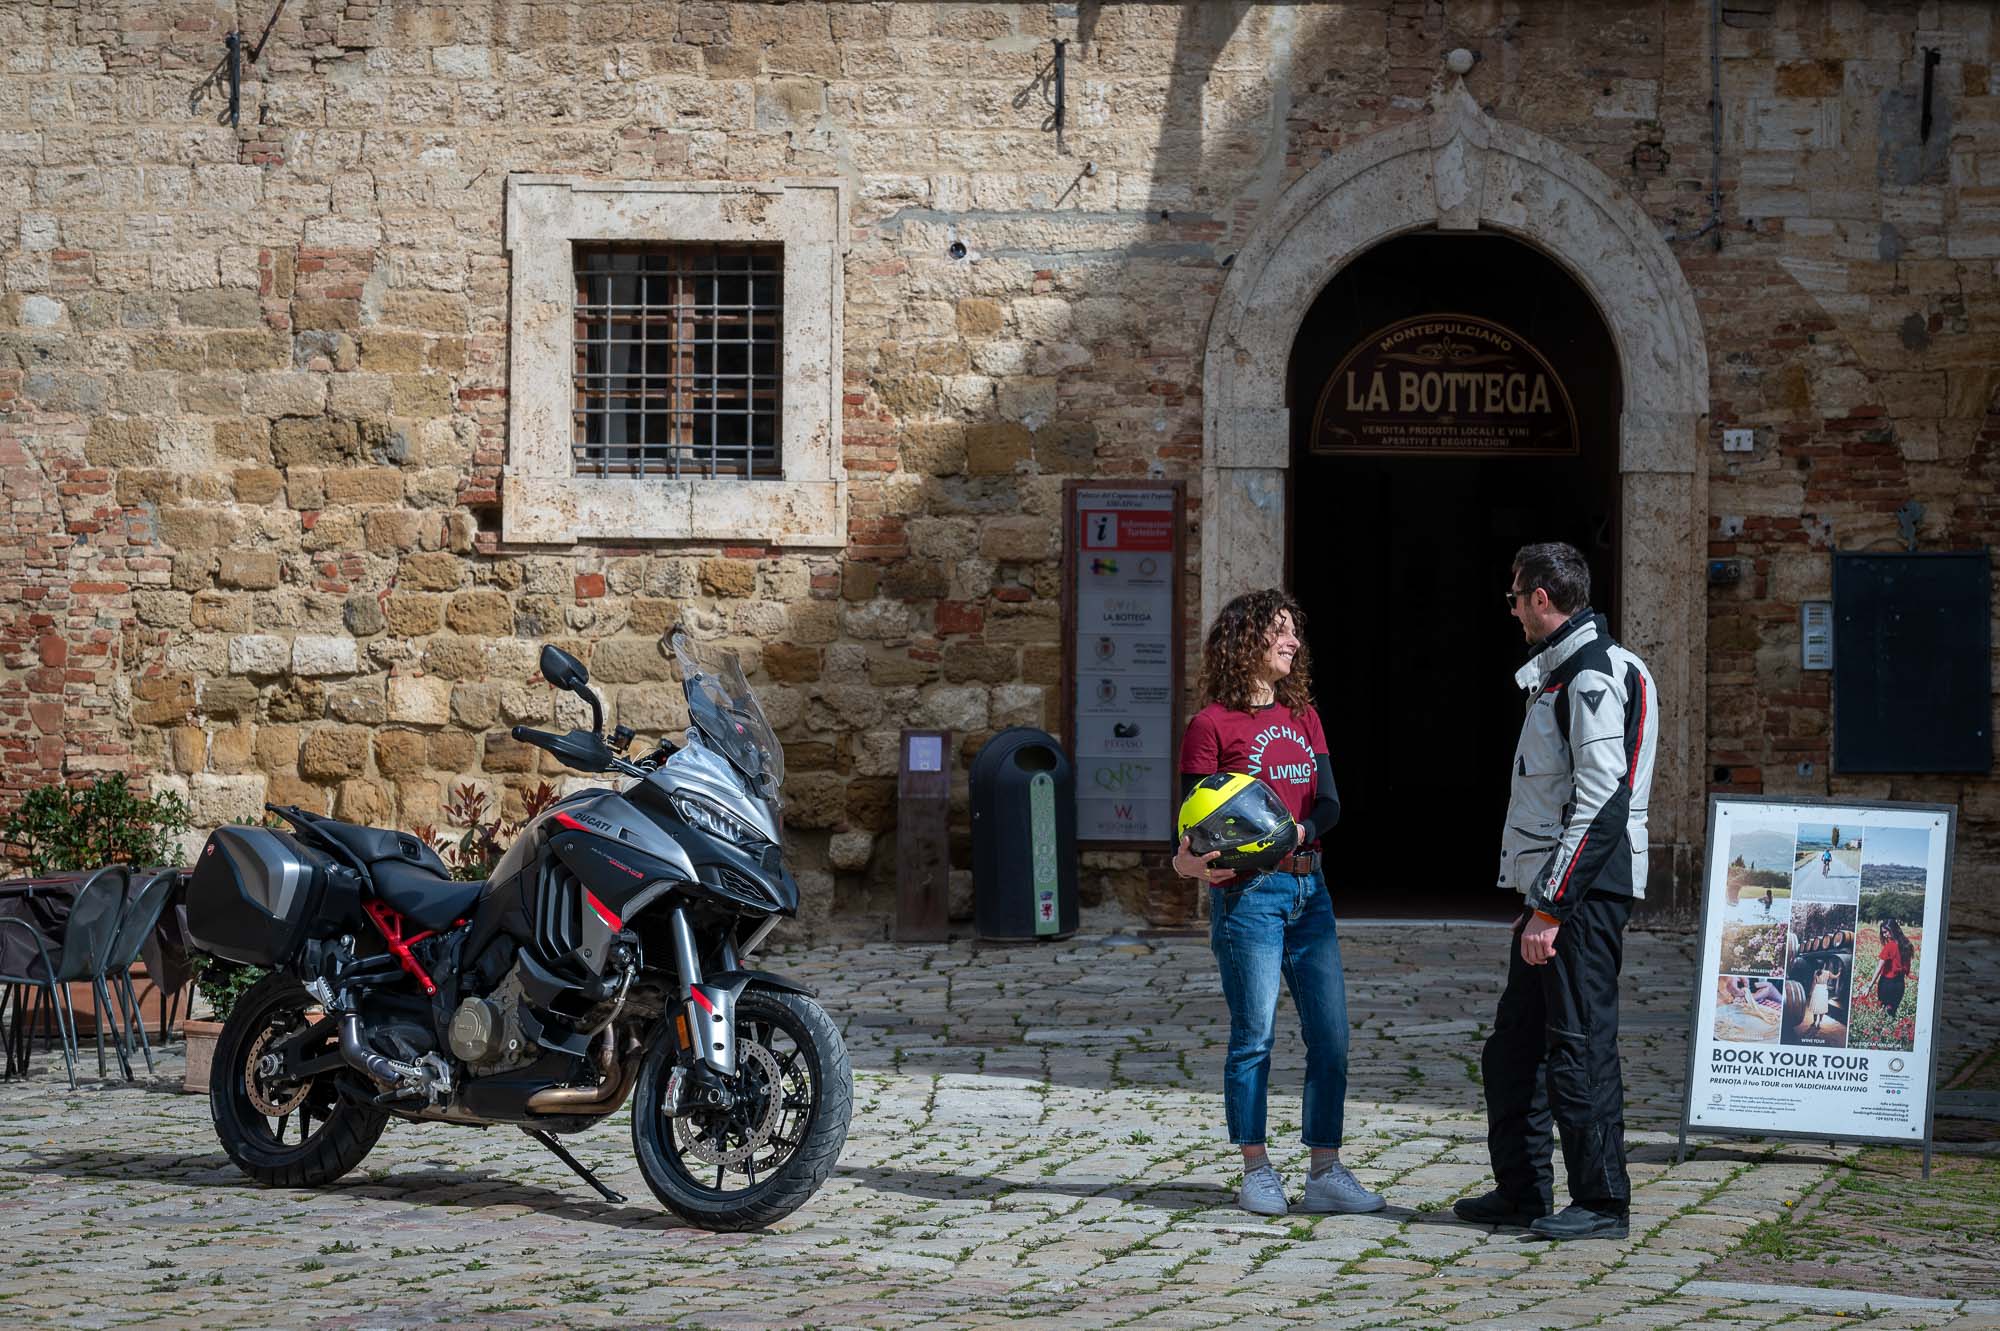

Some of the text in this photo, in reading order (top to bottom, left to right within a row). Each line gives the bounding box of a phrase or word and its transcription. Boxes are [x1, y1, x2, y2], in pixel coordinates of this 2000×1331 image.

[1380, 323, 1513, 352] MONTEPULCIANO
[1345, 371, 1552, 413] LA BOTTEGA
[1362, 425, 1530, 436] VENDITA PRODOTTI LOCALI E VINI
[1381, 436, 1429, 446] APERITIVI
[1269, 763, 1311, 780] LIVING
[574, 812, 612, 832] DUCATI
[1712, 1048, 1869, 1071] BOOK YOUR TOUR
[1711, 1063, 1869, 1082] WITH VALDICHIANA LIVING
[1709, 1077, 1741, 1086] PRENOTA
[1761, 1080, 1780, 1088] TOUR
[1794, 1082, 1842, 1092] VALDICHIANA
[1843, 1085, 1868, 1093] LIVING
